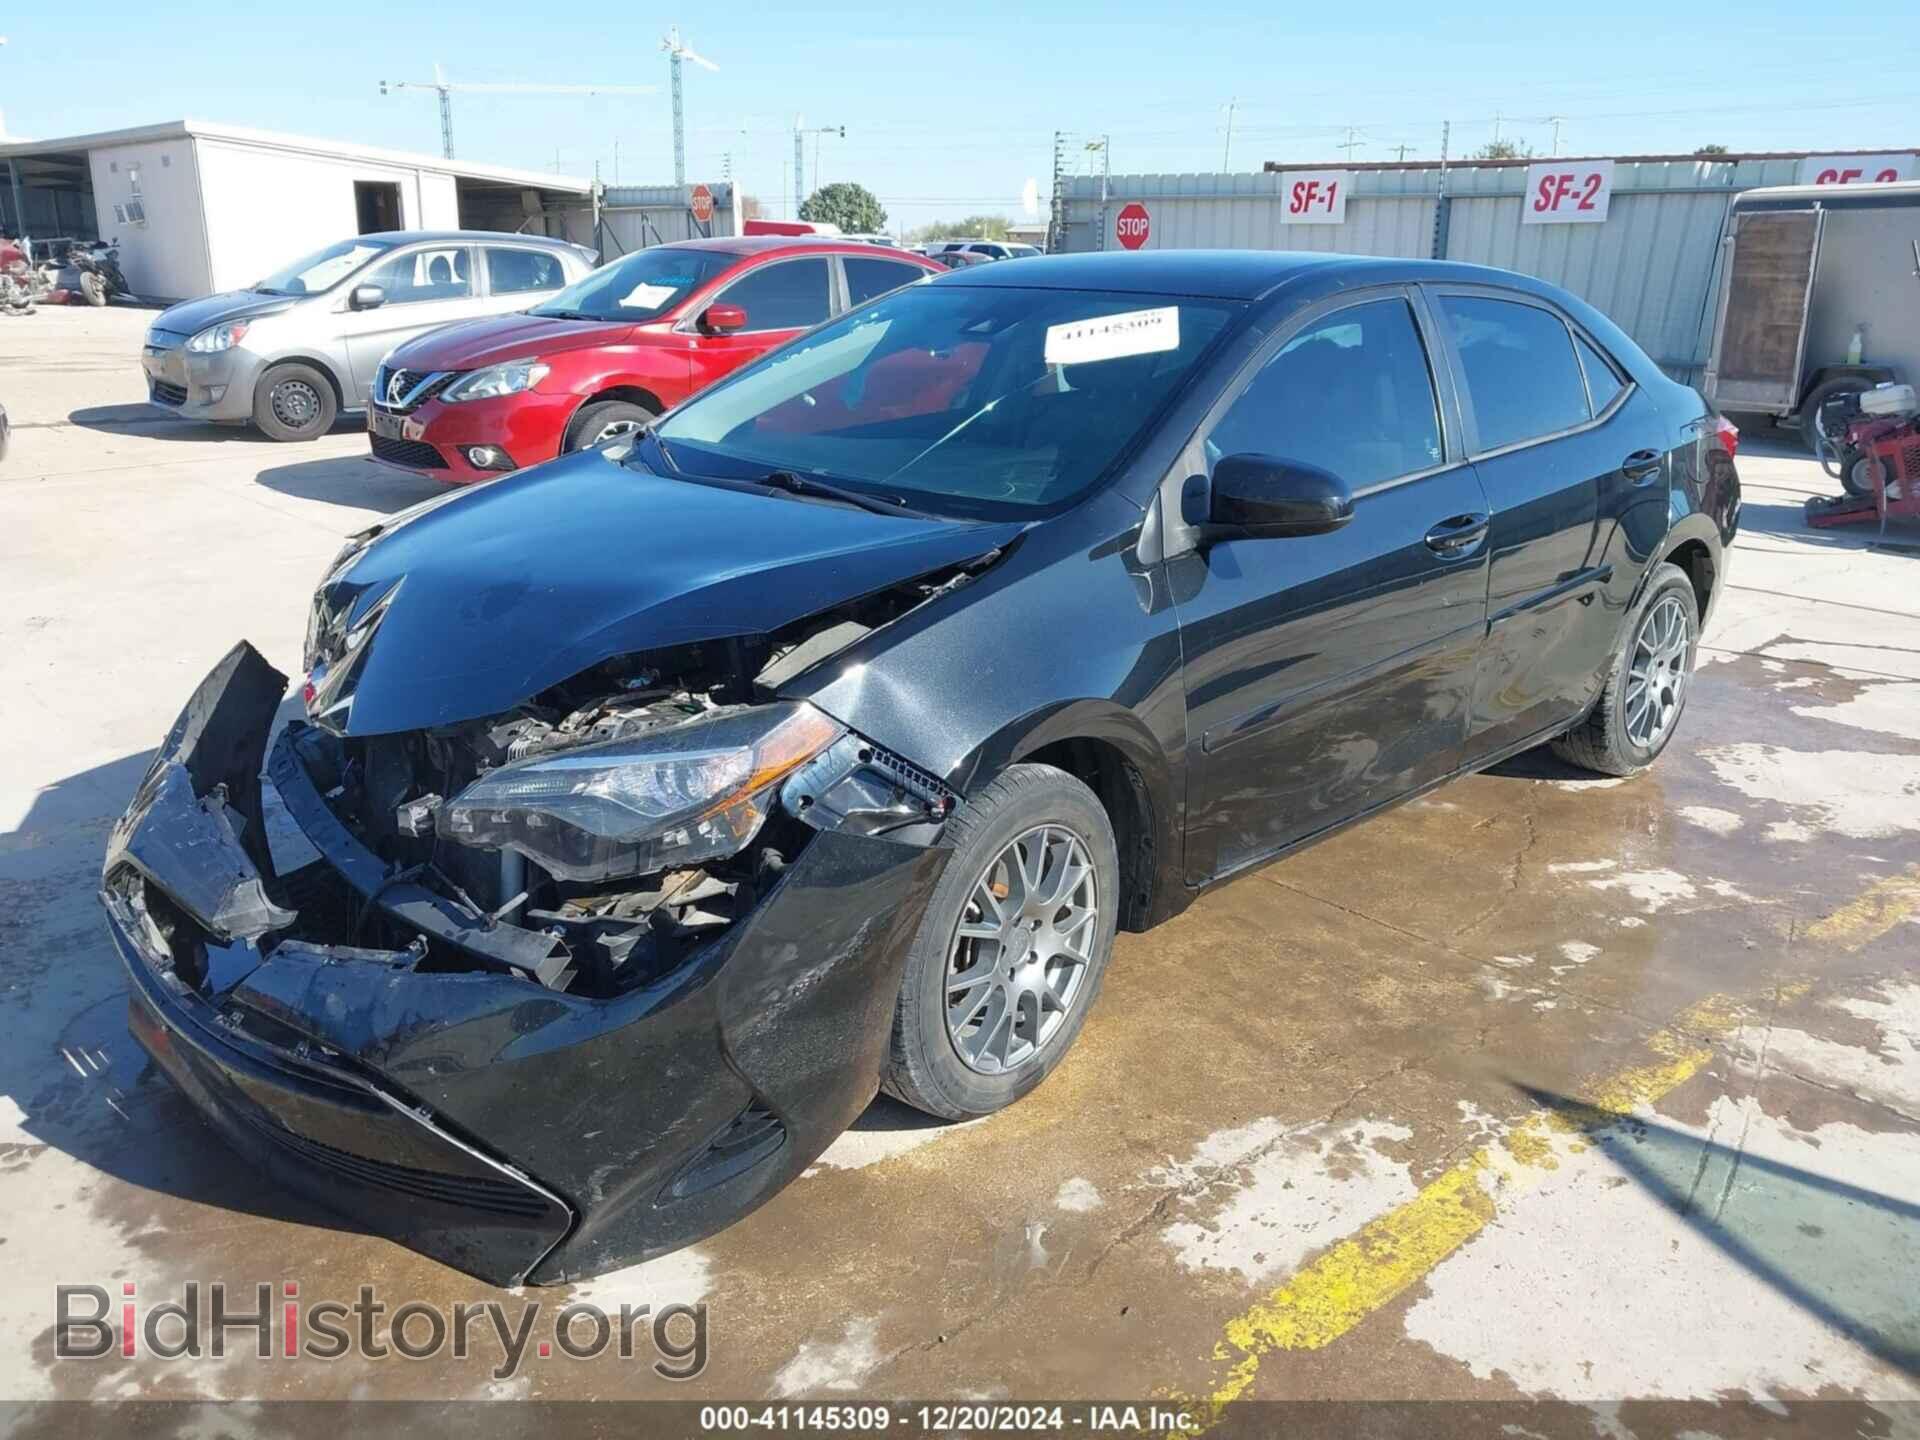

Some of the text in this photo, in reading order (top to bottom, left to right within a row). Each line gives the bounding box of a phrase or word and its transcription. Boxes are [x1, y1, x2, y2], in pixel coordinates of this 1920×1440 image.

[693, 195, 712, 210] STOP
[1290, 181, 1337, 213] SF-1
[1534, 173, 1602, 212] SF-2
[1118, 218, 1148, 236] STOP
